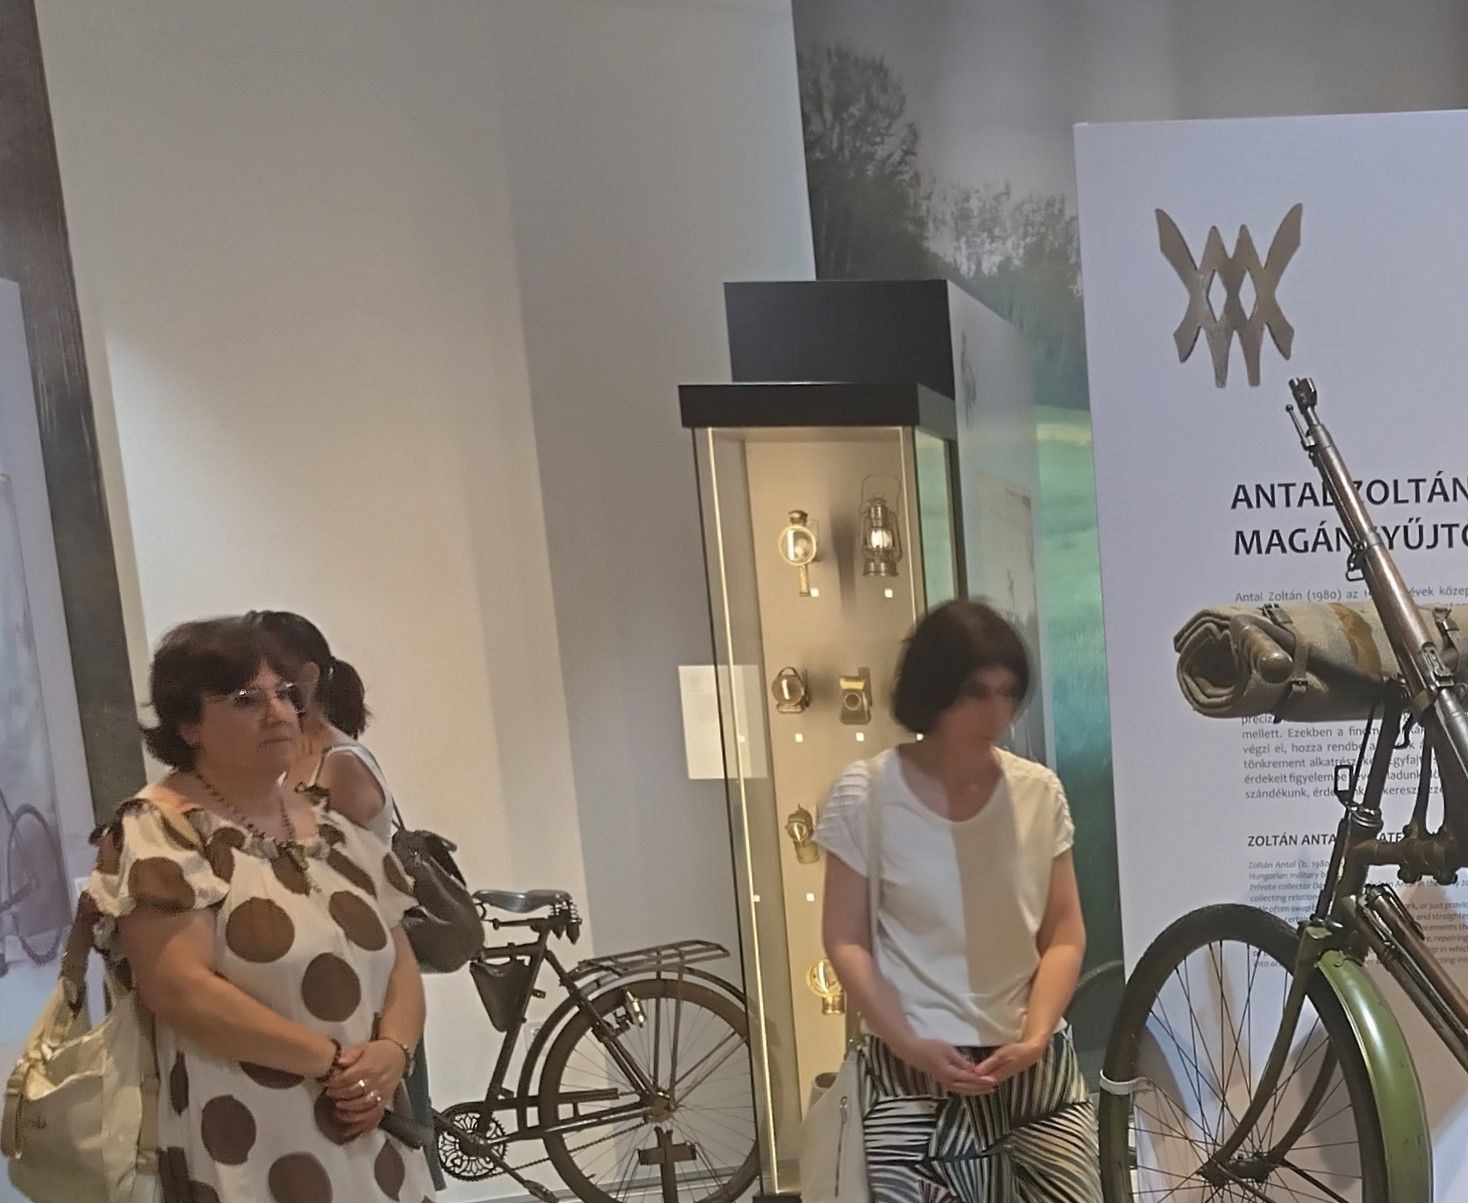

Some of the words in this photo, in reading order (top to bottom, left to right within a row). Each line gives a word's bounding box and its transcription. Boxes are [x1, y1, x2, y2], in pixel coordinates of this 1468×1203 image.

[1231, 482, 1336, 509] ANTAL
[1235, 592, 1263, 602] Antal
[1268, 590, 1302, 602] Zoltán
[1307, 589, 1342, 603] (1980)
[1346, 592, 1358, 600] az
[1242, 727, 1283, 739] mellett.
[1288, 727, 1333, 738] Ezekben
[1337, 728, 1344, 736] a
[1243, 741, 1271, 755] végzi
[1274, 742, 1288, 754] el,
[1291, 741, 1322, 752] hozza
[1244, 757, 1306, 769] tönkrement
[1244, 773, 1288, 784] érdekeit
[1245, 788, 1310, 799] szándékunk,
[1248, 832, 1297, 847] ZOLTÁN
[1301, 833, 1336, 846] ANTA
